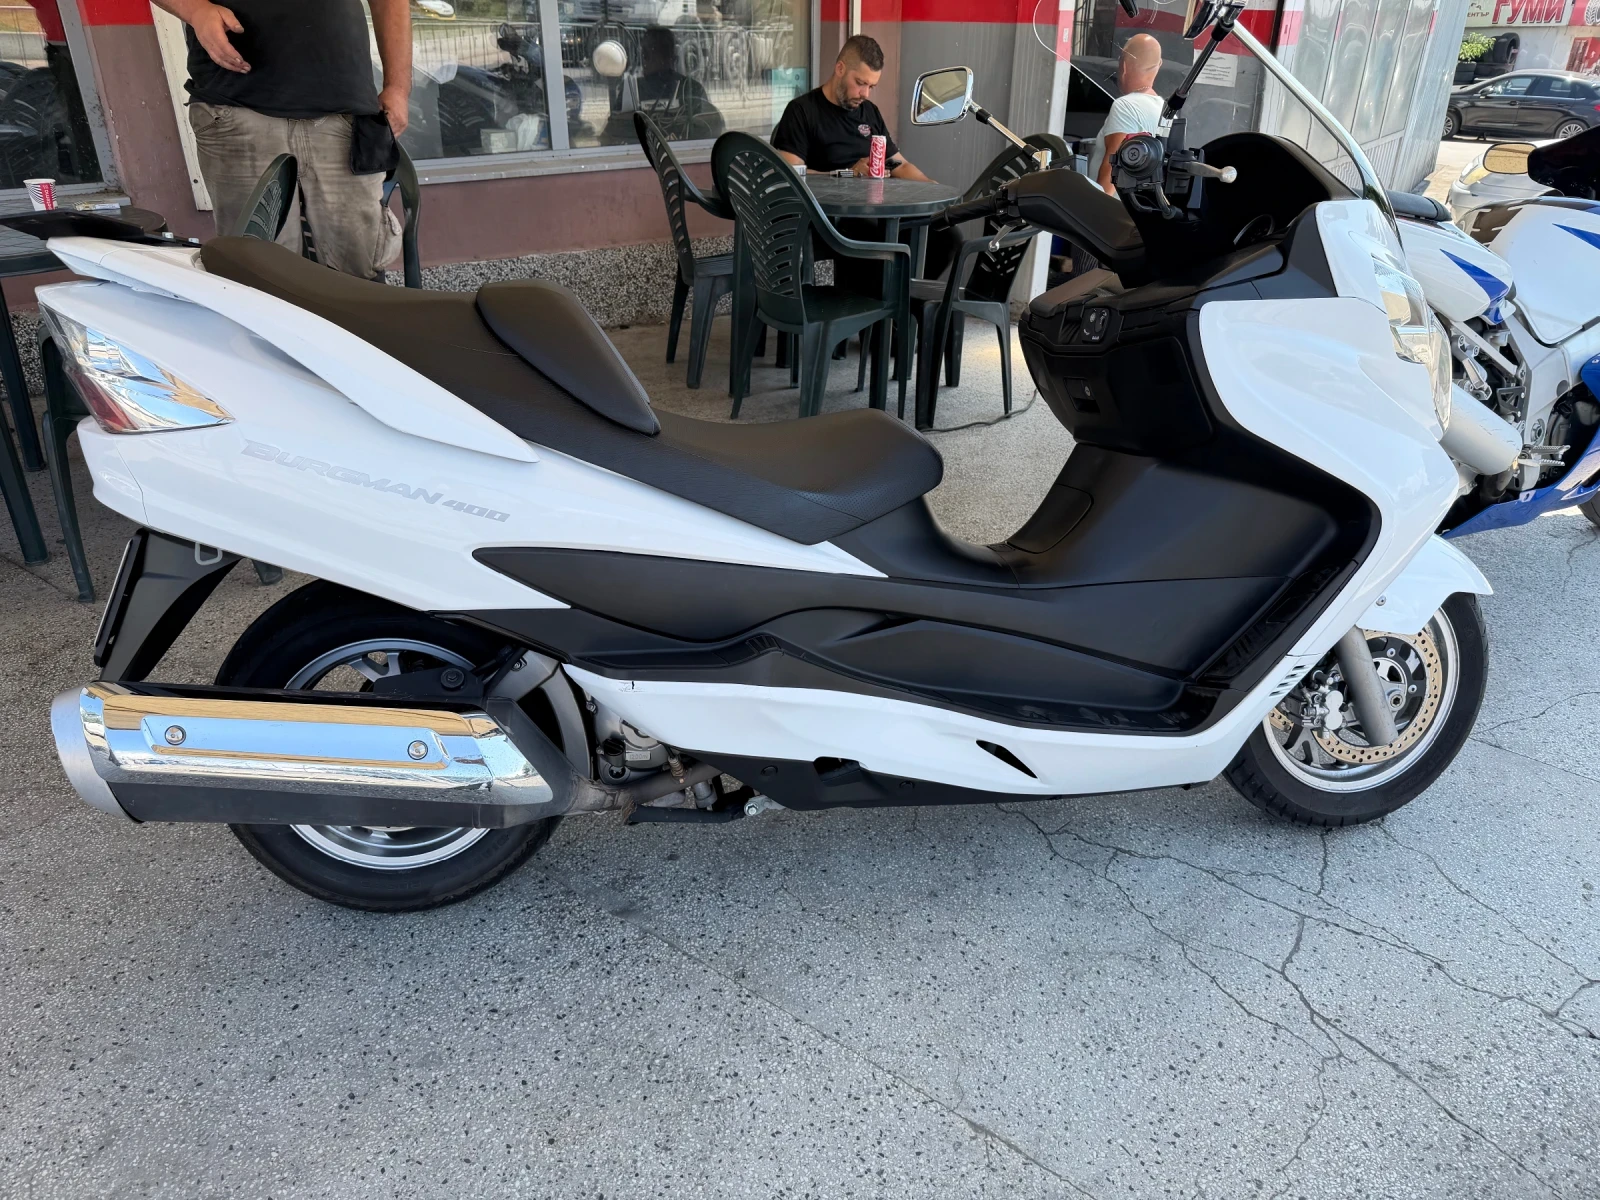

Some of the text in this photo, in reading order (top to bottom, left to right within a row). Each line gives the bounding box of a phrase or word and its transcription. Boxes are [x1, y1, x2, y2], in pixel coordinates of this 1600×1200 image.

[1492, 0, 1566, 24] ГУМИ
[241, 438, 511, 523] BURGMAN 400
